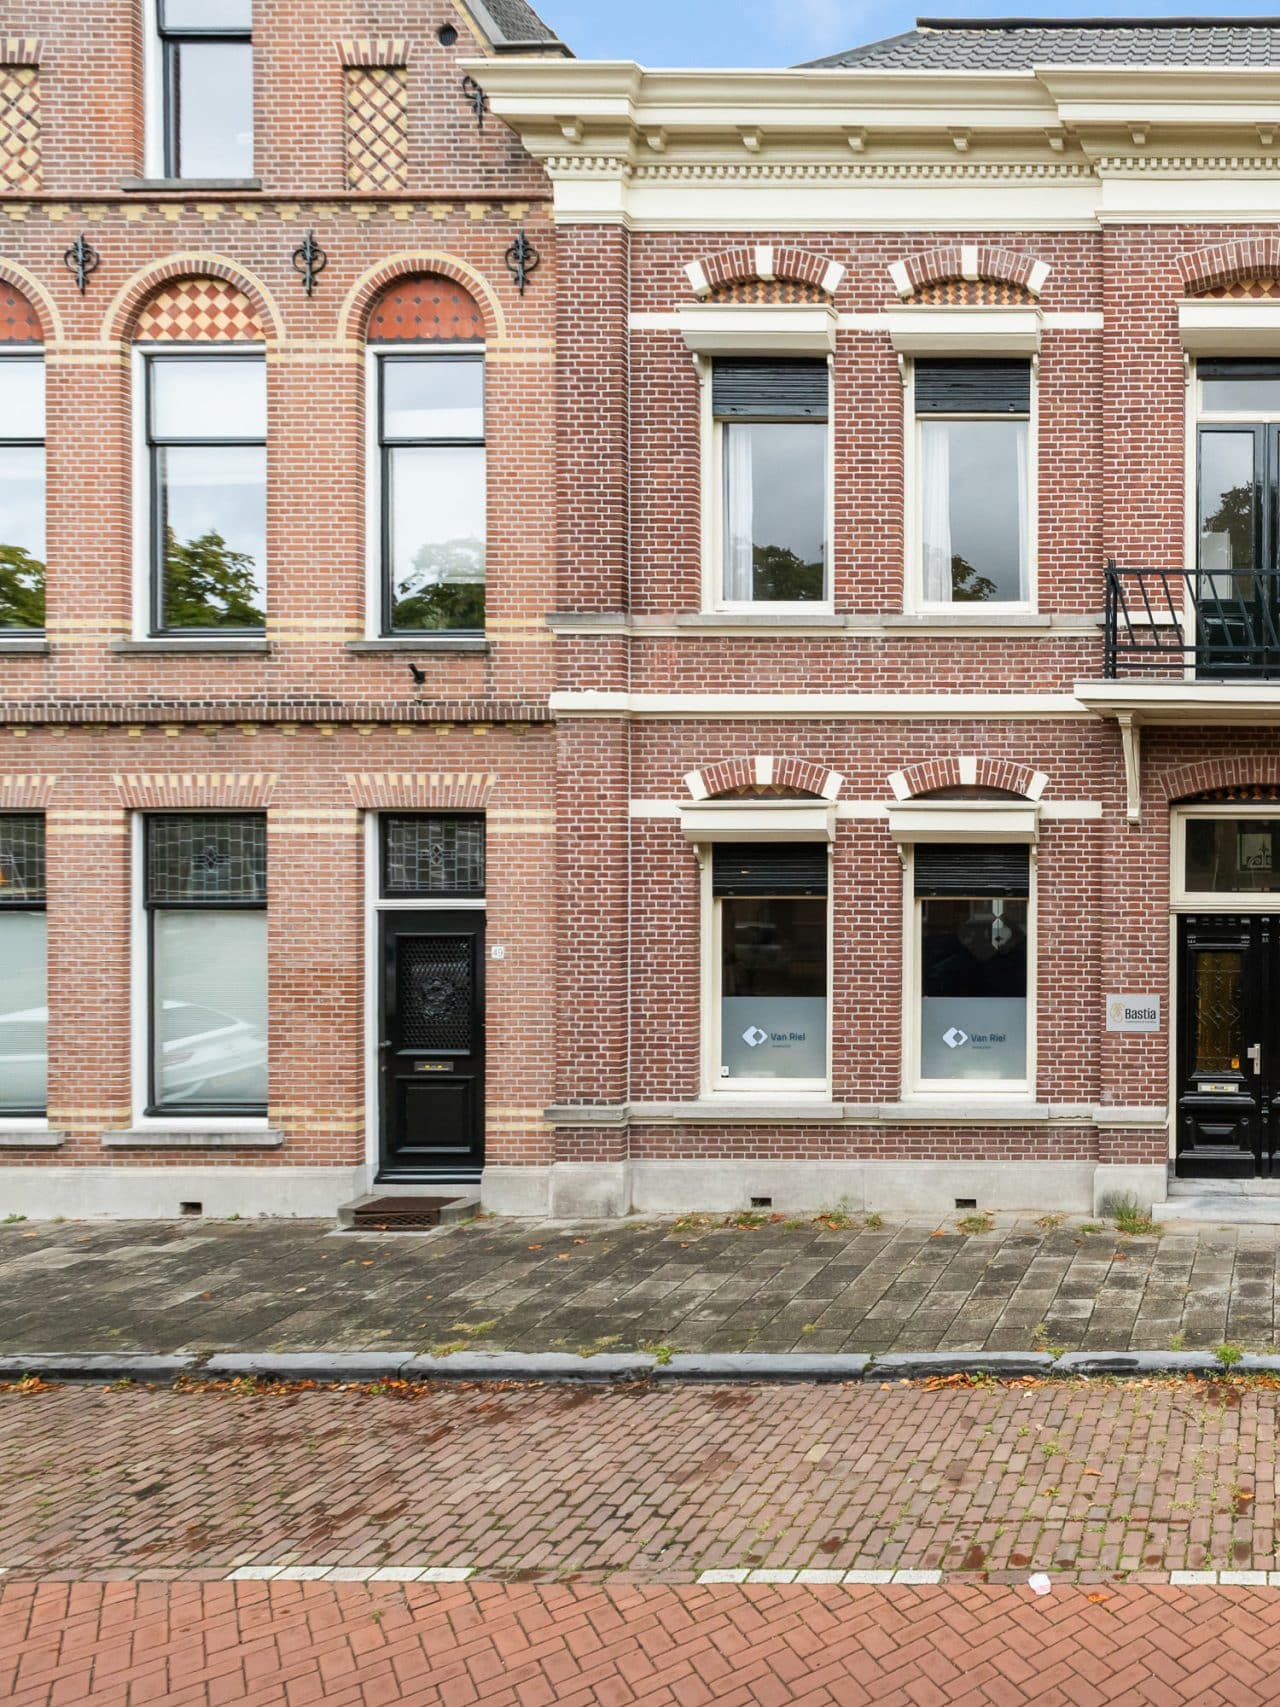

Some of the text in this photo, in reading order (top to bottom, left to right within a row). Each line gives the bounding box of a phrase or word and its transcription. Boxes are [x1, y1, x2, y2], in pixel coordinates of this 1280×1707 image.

[1125, 1007, 1157, 1020] Bastia
[770, 1031, 805, 1041] Van Riel
[971, 1033, 1006, 1042] Van Riel
